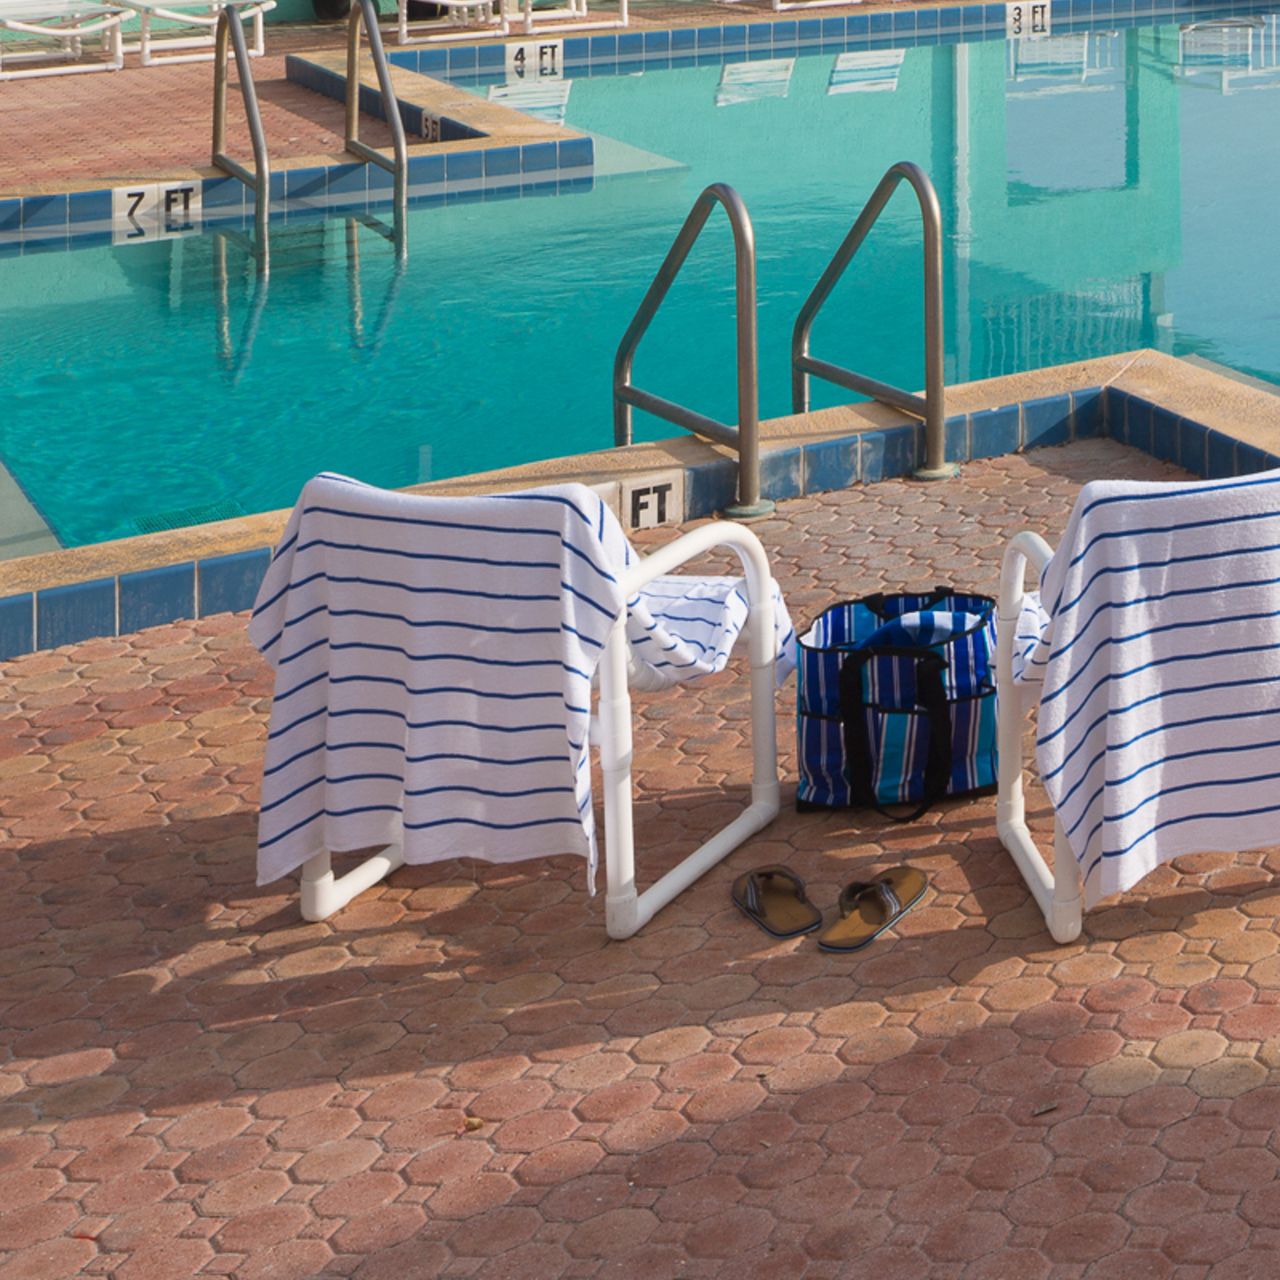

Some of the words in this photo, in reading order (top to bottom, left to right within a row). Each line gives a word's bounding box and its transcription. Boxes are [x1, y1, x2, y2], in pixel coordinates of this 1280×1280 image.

[1012, 6, 1022, 22] 3
[1032, 4, 1046, 21] FT
[513, 47, 526, 64] 4
[540, 44, 558, 63] FT
[127, 191, 145, 217] 7
[165, 187, 194, 212] FT
[631, 483, 672, 529] FT
